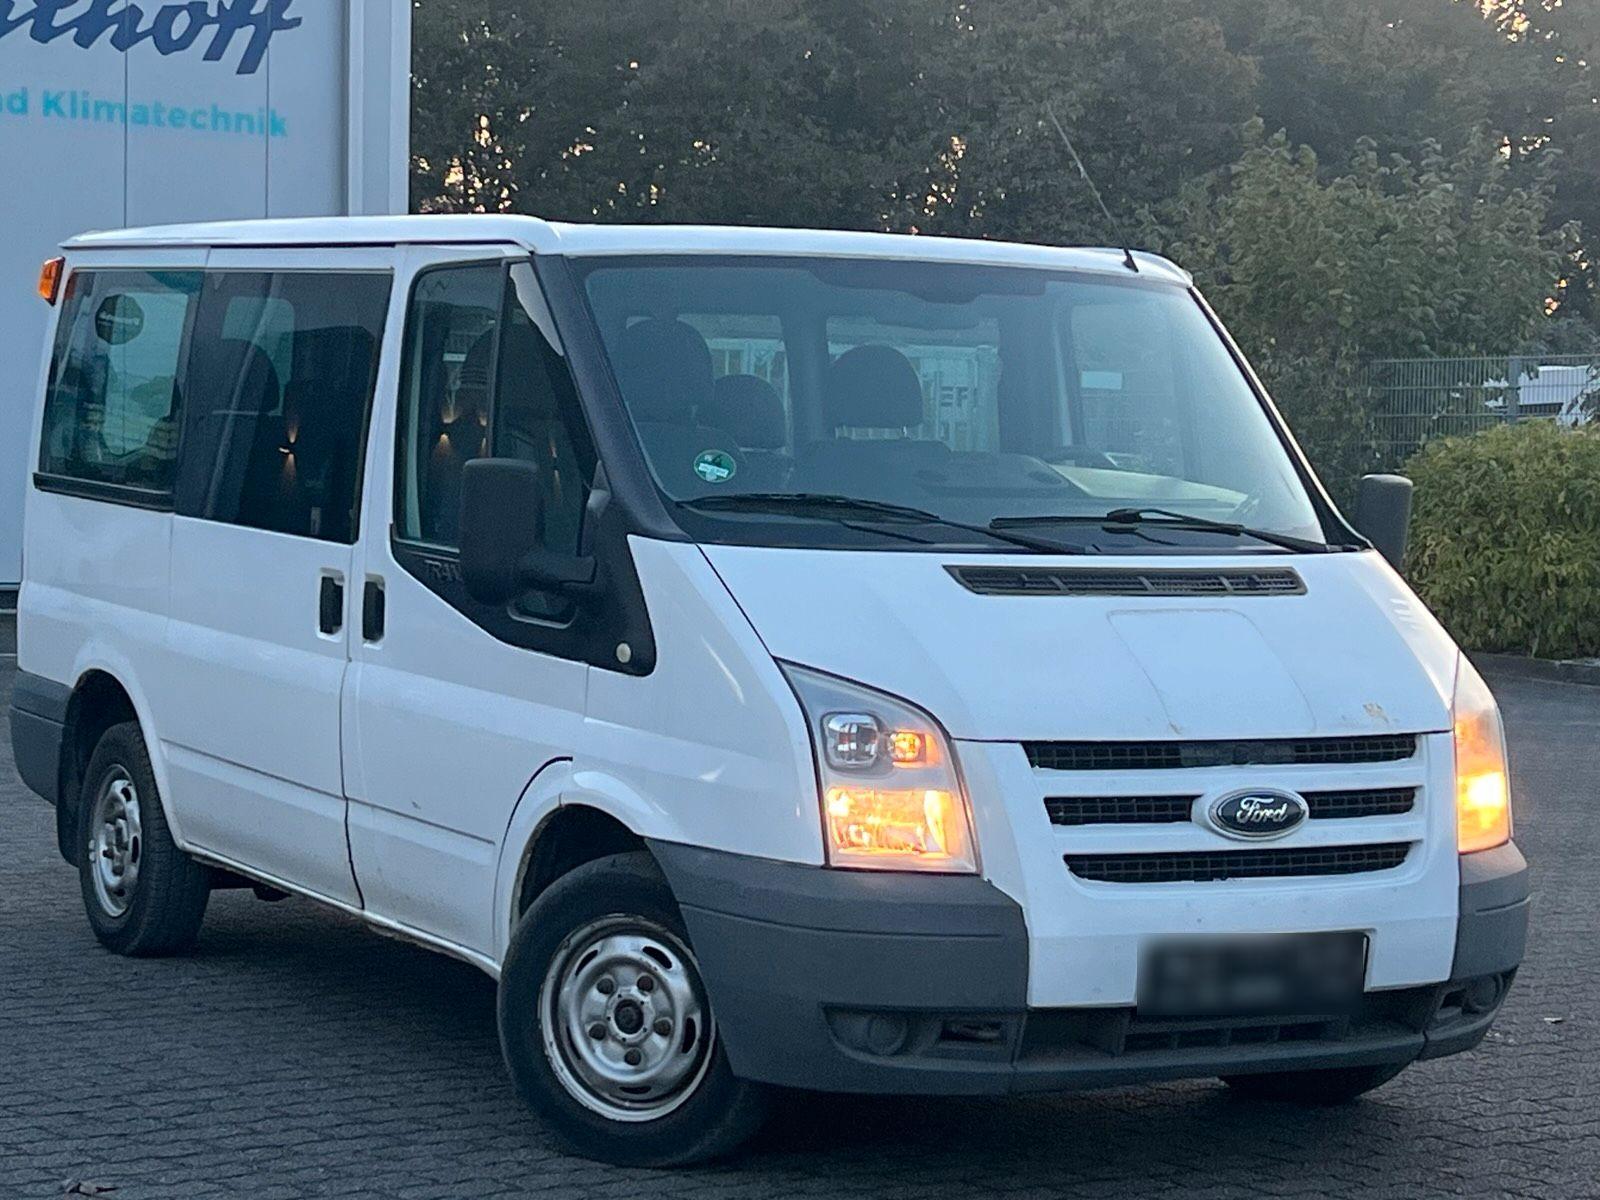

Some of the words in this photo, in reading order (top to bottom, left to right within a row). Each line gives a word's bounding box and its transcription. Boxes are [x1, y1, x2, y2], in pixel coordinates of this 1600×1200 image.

[0, 87, 28, 115] d
[42, 90, 288, 137] Klimatechnik
[1236, 797, 1288, 823] Ford
